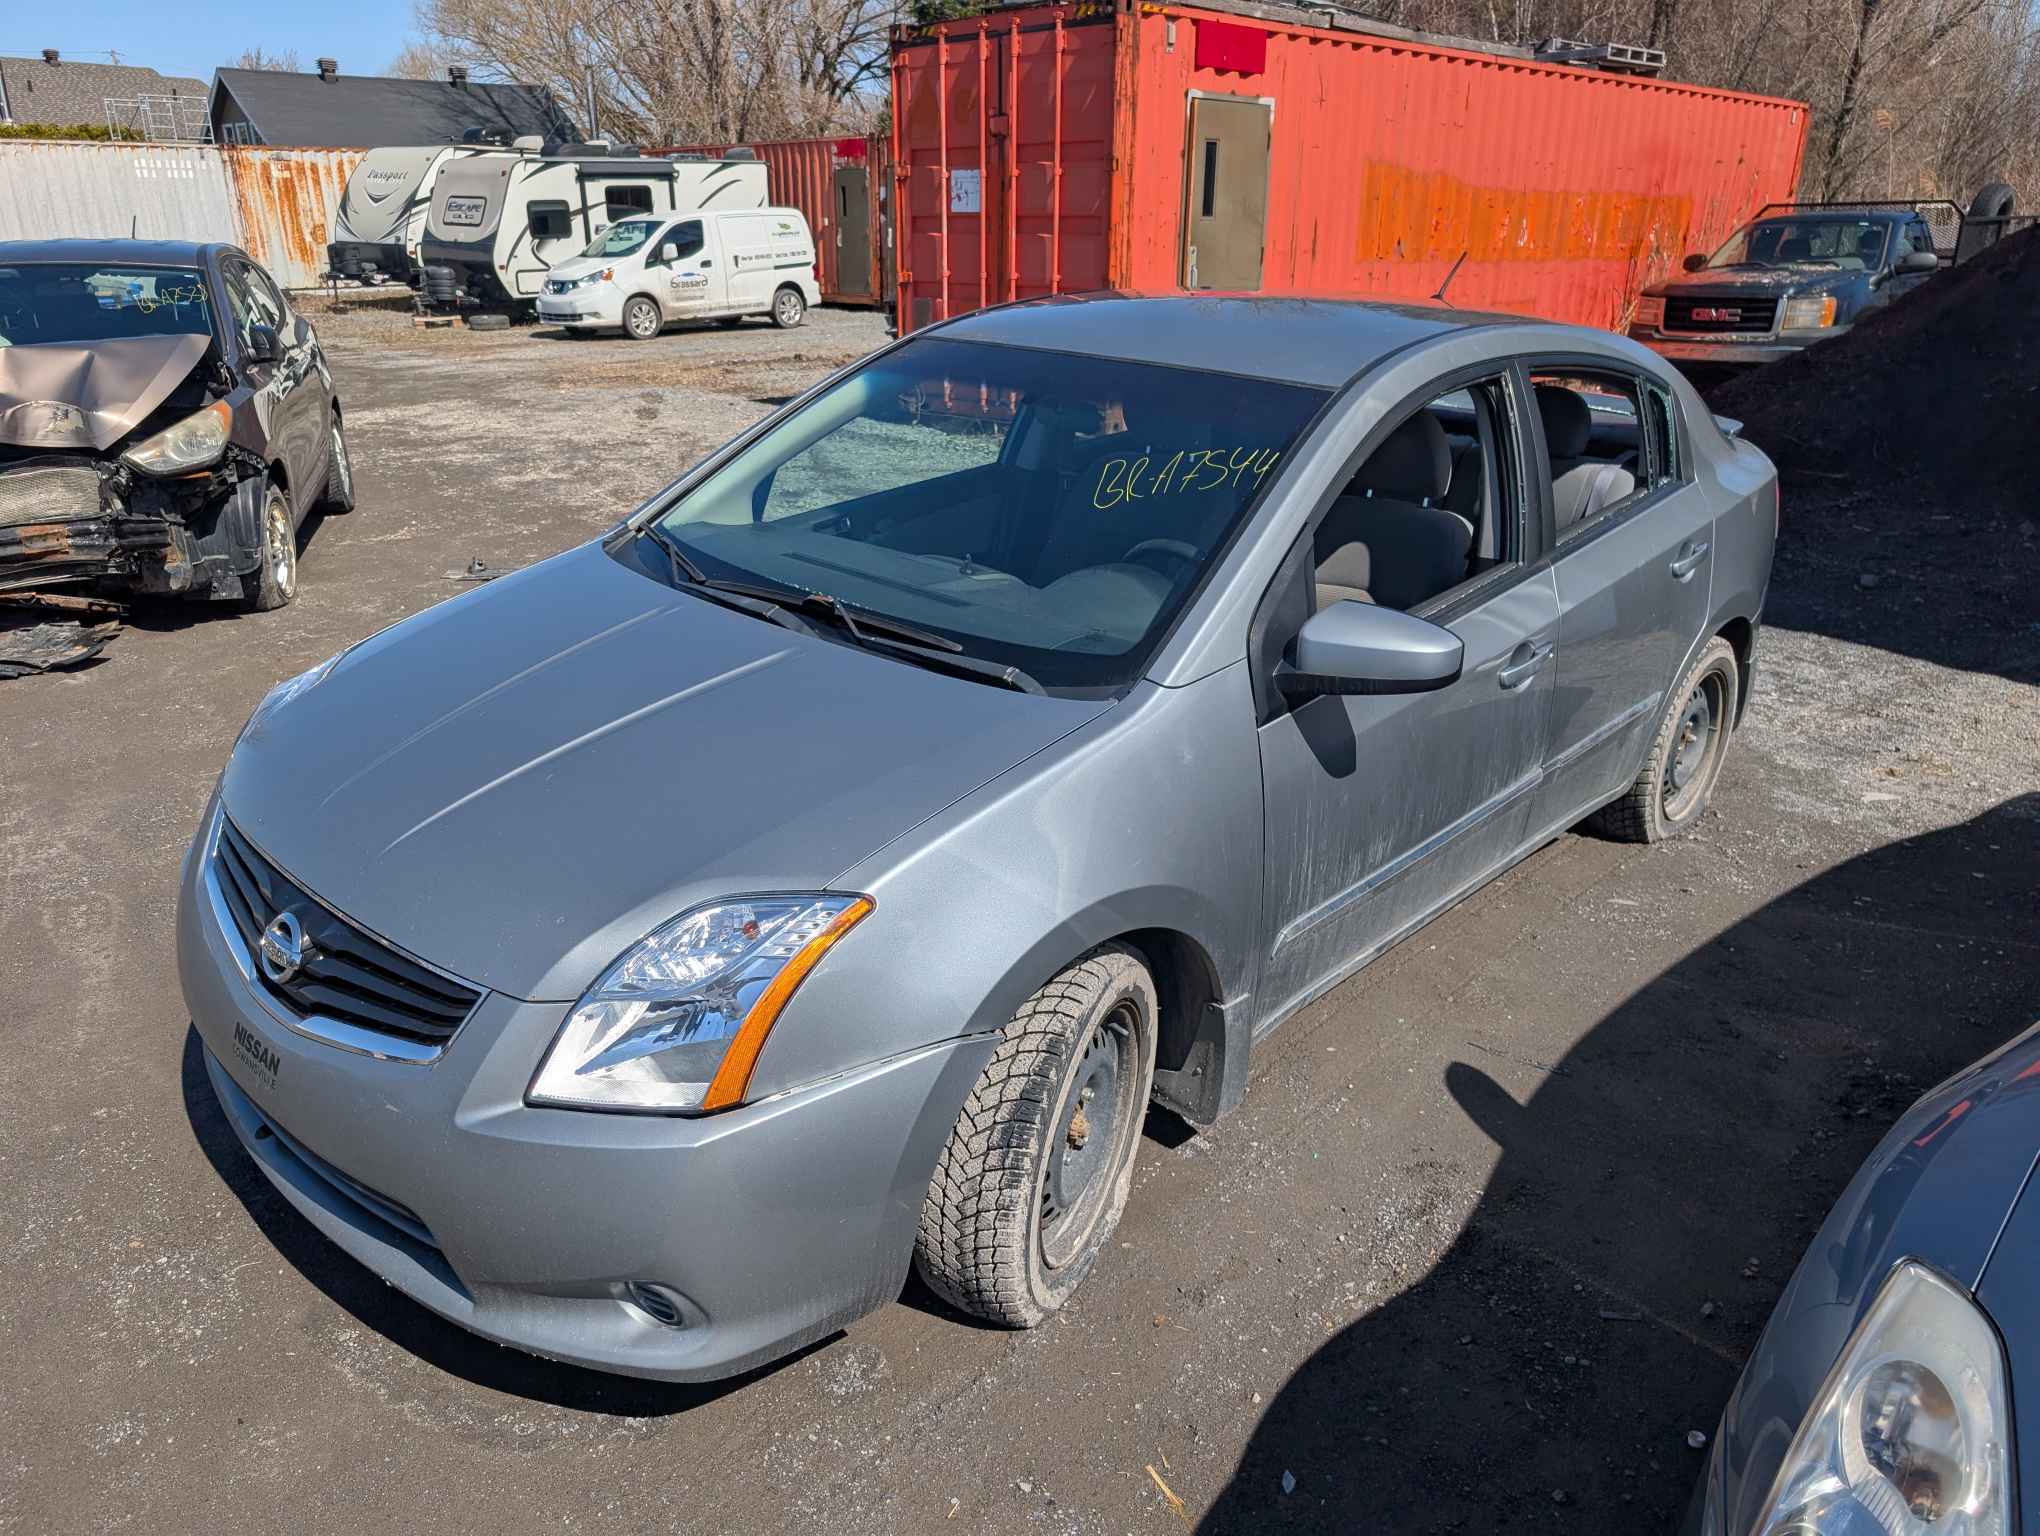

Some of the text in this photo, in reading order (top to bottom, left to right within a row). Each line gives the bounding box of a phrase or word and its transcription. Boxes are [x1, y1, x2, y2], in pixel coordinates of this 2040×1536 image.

[368, 168, 408, 181] Passport
[1691, 308, 1742, 321] GMC
[233, 1021, 281, 1076] NISSAN
